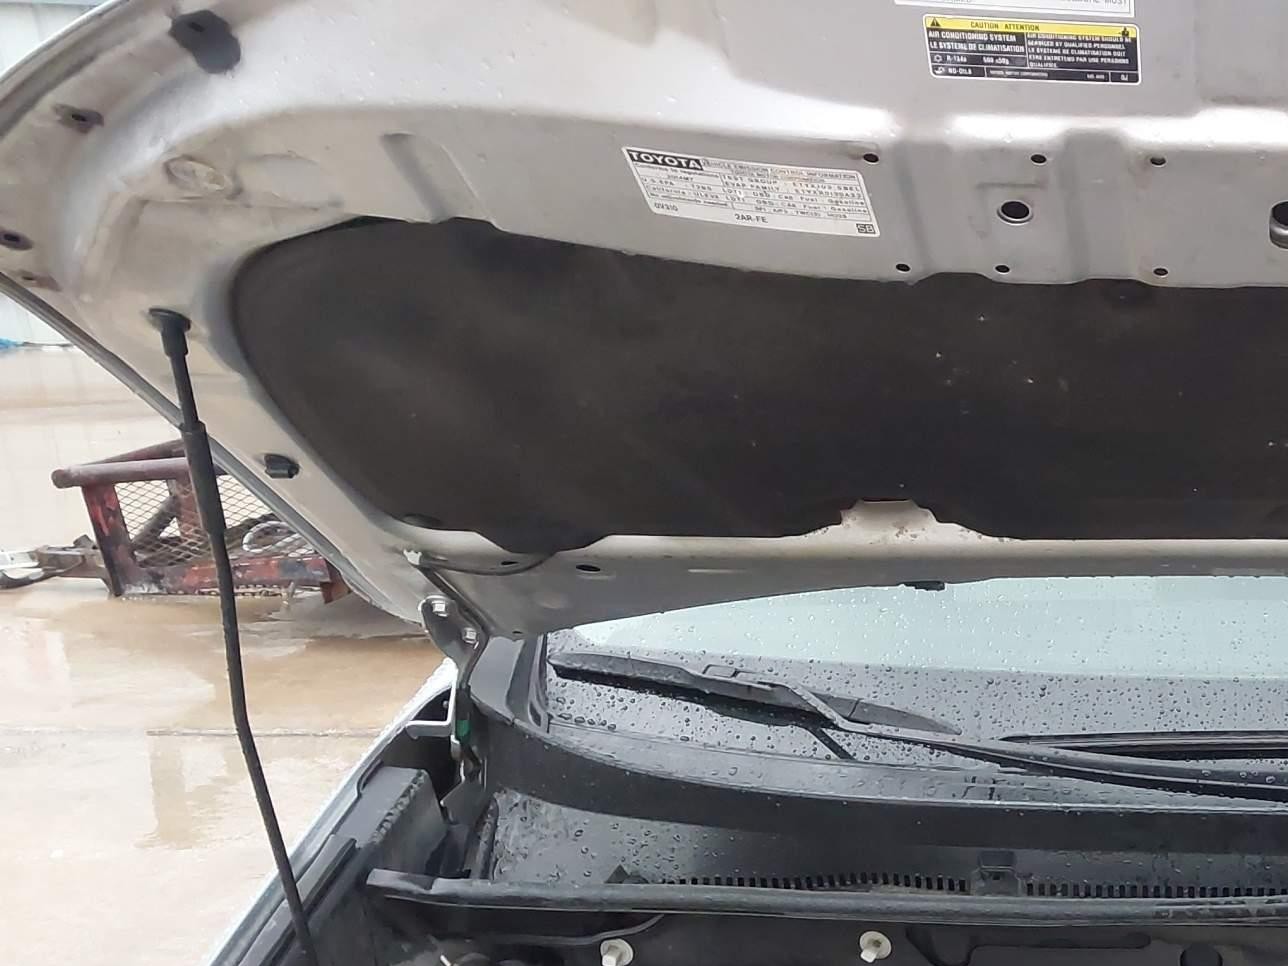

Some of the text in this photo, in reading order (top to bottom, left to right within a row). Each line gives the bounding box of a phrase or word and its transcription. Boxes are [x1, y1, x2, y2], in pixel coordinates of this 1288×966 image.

[971, 21, 1039, 32] CAUTION ATTENTION
[941, 32, 988, 41] CONDITIONING
[990, 34, 1017, 42] SYSTEM
[978, 44, 1025, 53] CLIMATISATION
[629, 151, 702, 169] TOYOTA
[858, 225, 874, 234] SB
